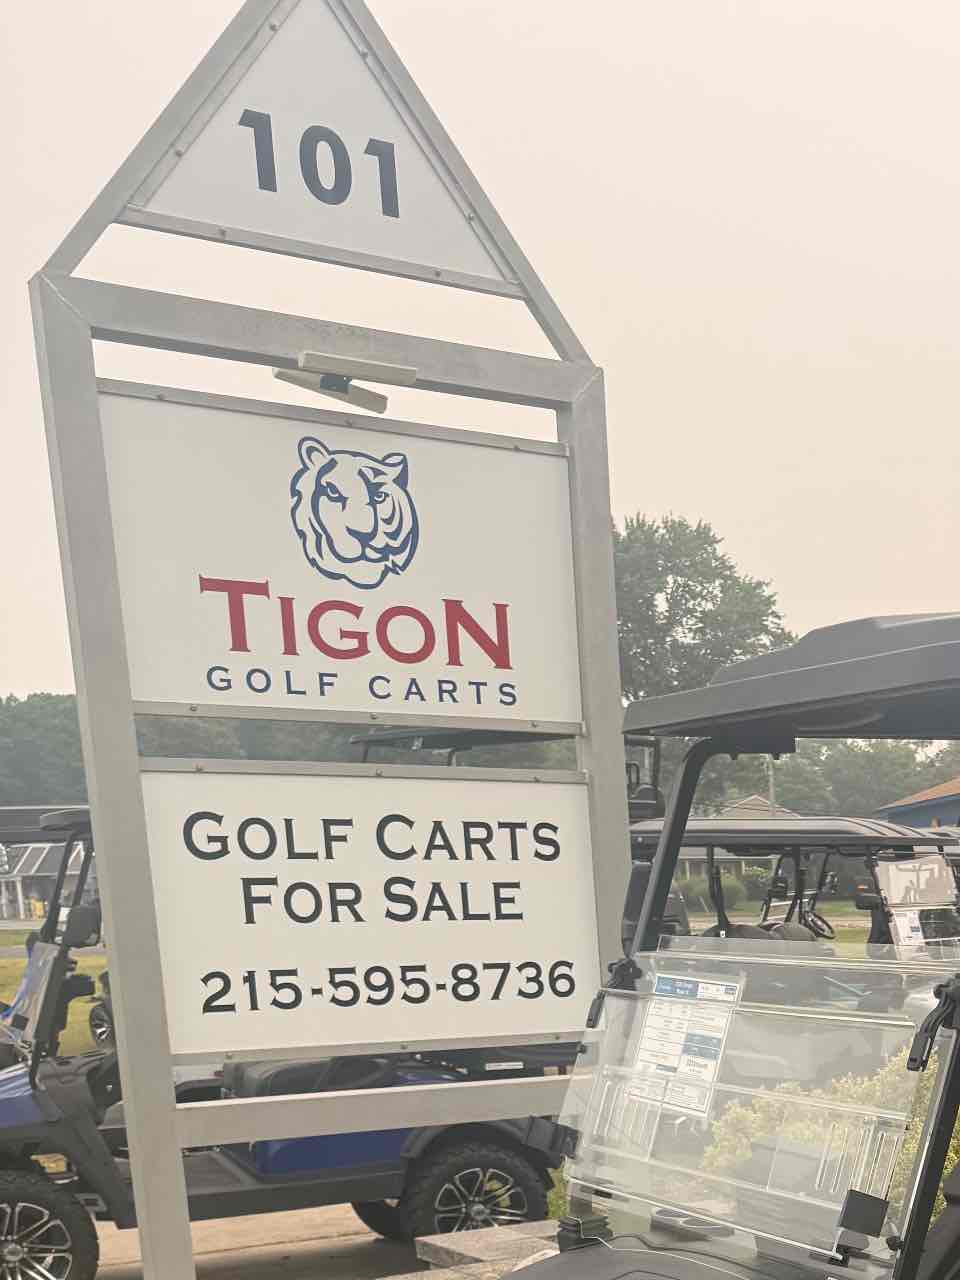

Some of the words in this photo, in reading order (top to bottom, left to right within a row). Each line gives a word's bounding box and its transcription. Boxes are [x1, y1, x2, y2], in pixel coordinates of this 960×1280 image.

[238, 109, 400, 218] 101
[199, 575, 513, 670] TIGON
[207, 666, 338, 697] GOLF
[368, 675, 517, 706] CARTS
[183, 811, 353, 861] GOLF
[376, 814, 561, 862] CARTS
[240, 877, 365, 925] FOR
[384, 877, 524, 922] SALE
[201, 960, 576, 1015] 215-595-8736
